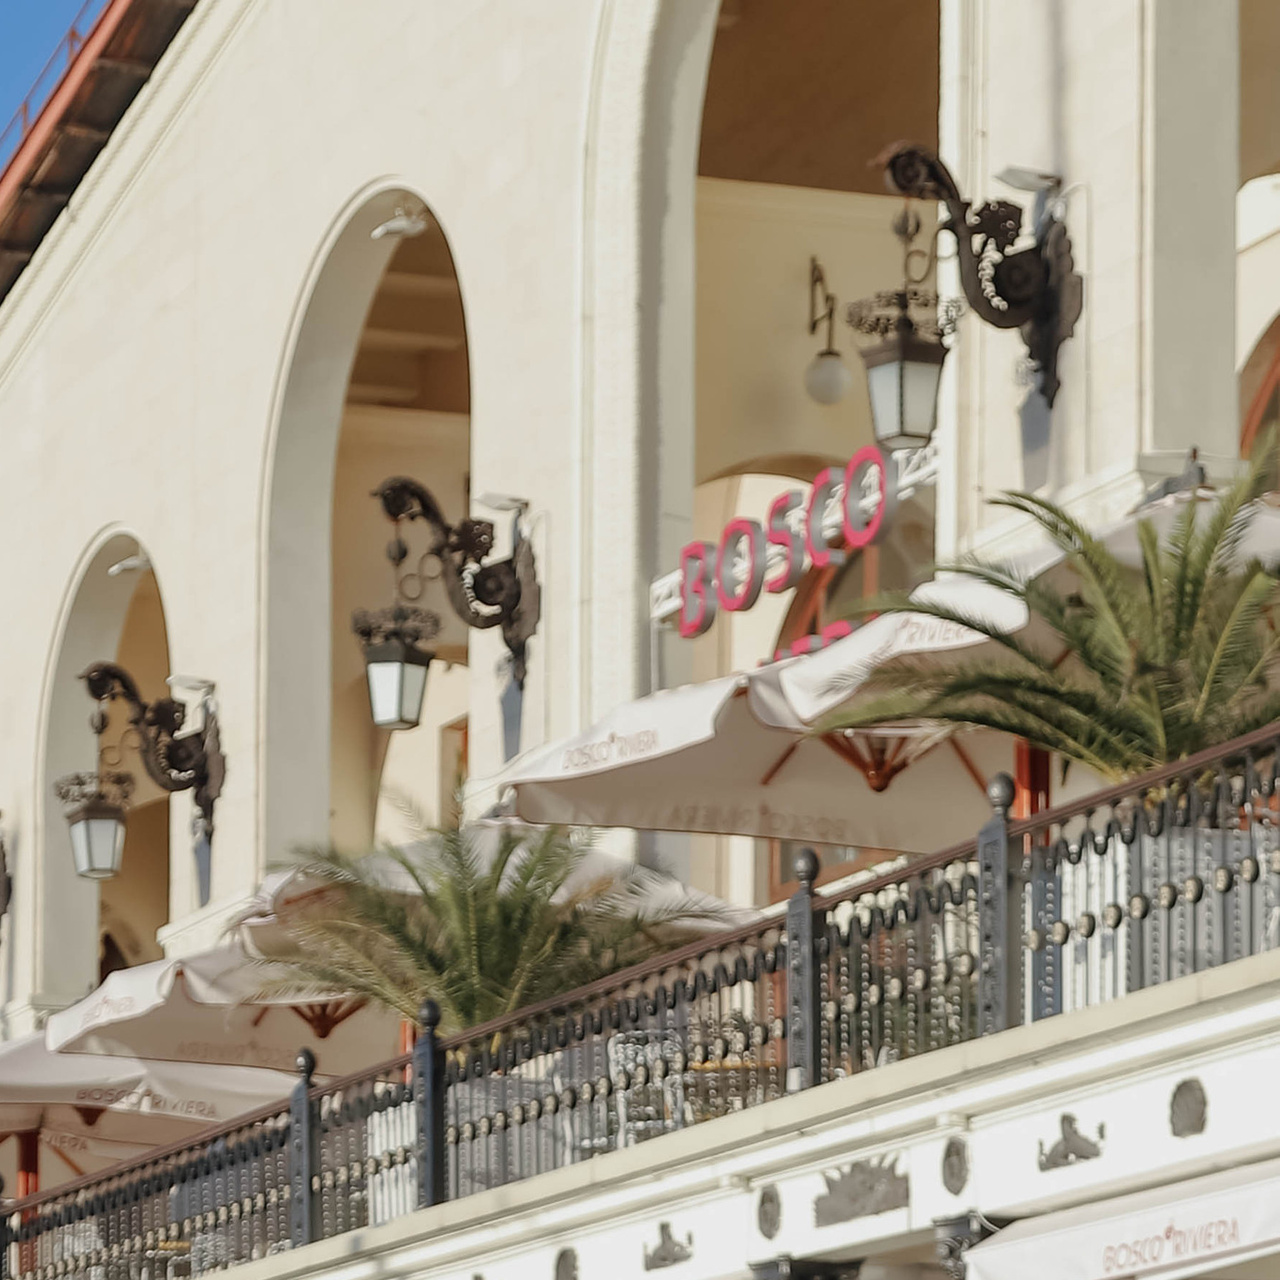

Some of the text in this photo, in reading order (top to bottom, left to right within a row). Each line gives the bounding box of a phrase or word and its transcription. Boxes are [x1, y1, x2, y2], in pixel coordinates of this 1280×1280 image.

[680, 444, 894, 638] BOSCO
[907, 620, 972, 645] RIVIER
[76, 1088, 140, 1110] BOSCO
[1104, 1218, 1239, 1273] BOSCO RIVIERA
